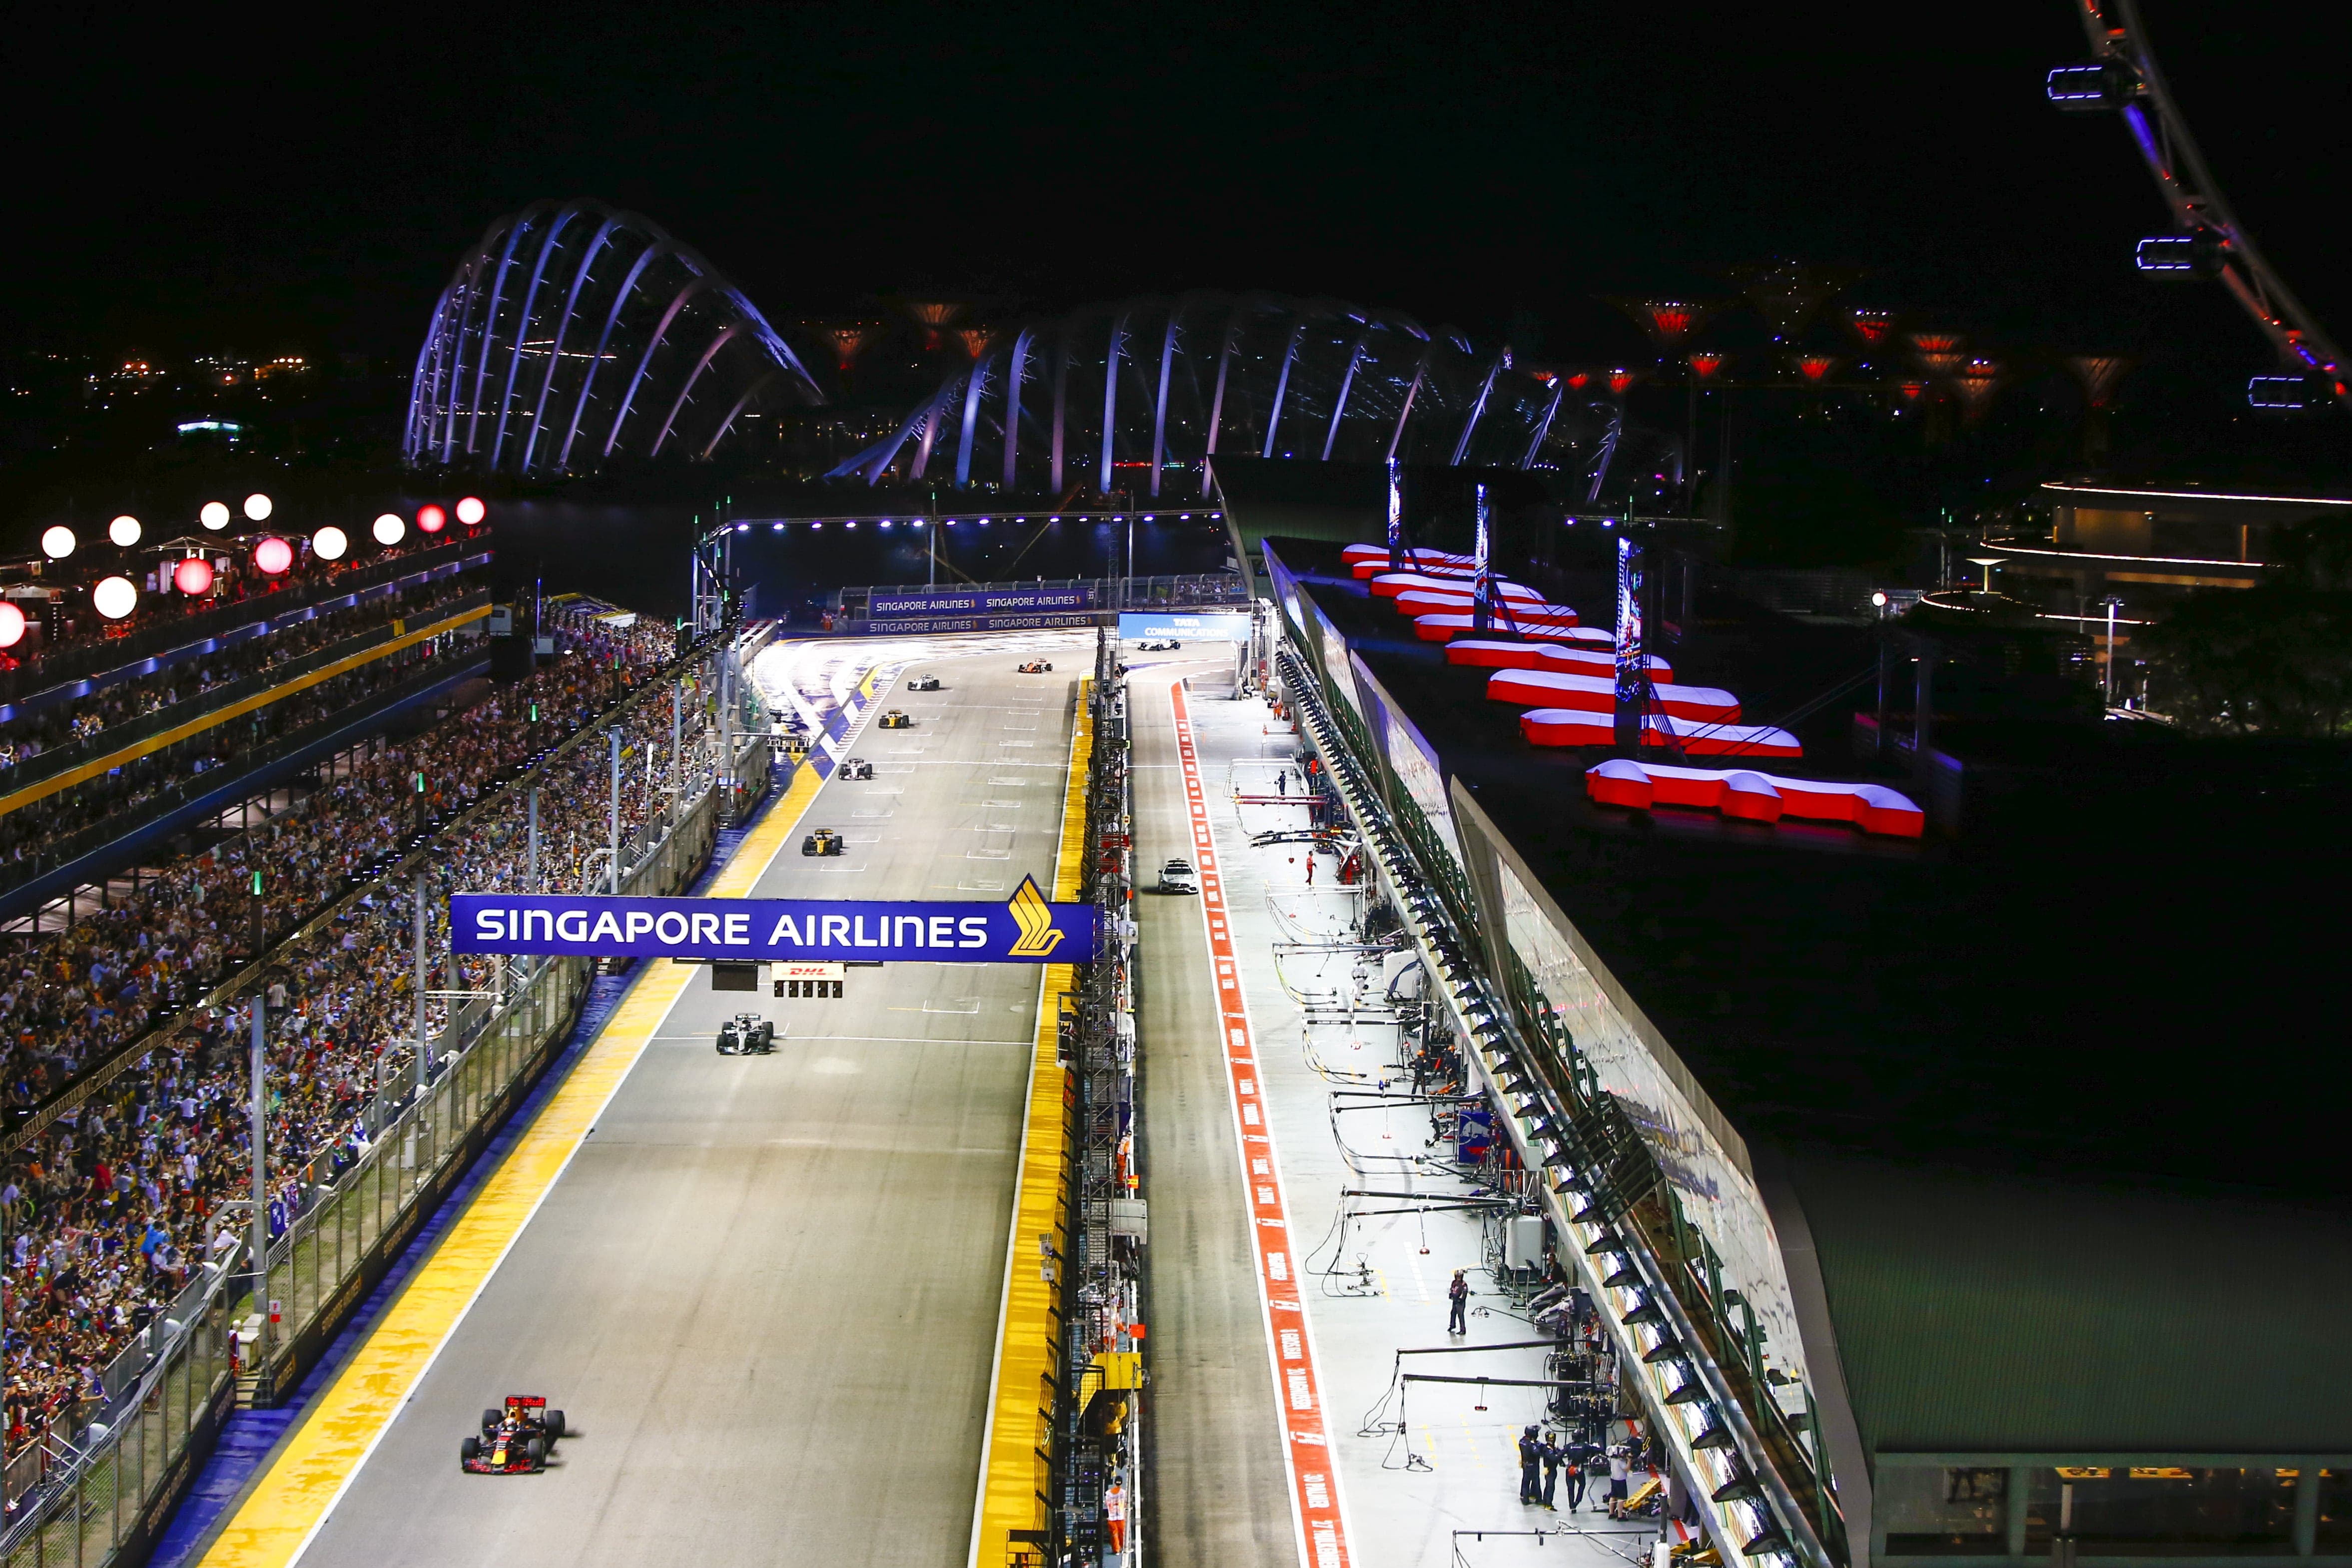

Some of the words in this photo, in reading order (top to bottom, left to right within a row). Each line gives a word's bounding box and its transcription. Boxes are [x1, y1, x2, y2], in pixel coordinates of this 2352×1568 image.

[876, 601, 927, 611] SINGAPORE
[929, 599, 970, 609] AIRLINES
[987, 597, 1034, 607] SINGAPORE
[1037, 595, 1075, 605] AIRLINES
[870, 622, 929, 632] SINGAPORE
[932, 620, 971, 630] AIRLINES
[989, 618, 1041, 628] SINGAPORE
[1044, 617, 1086, 626] AIRLINES
[1173, 618, 1200, 626] TATA
[1145, 627, 1228, 637] COMMUNICATIONS
[476, 909, 750, 946] SINGAPORE
[768, 914, 988, 948] AIRLINES
[1304, 1483, 1330, 1509] PALMER
[1311, 1520, 1334, 1530] 27
